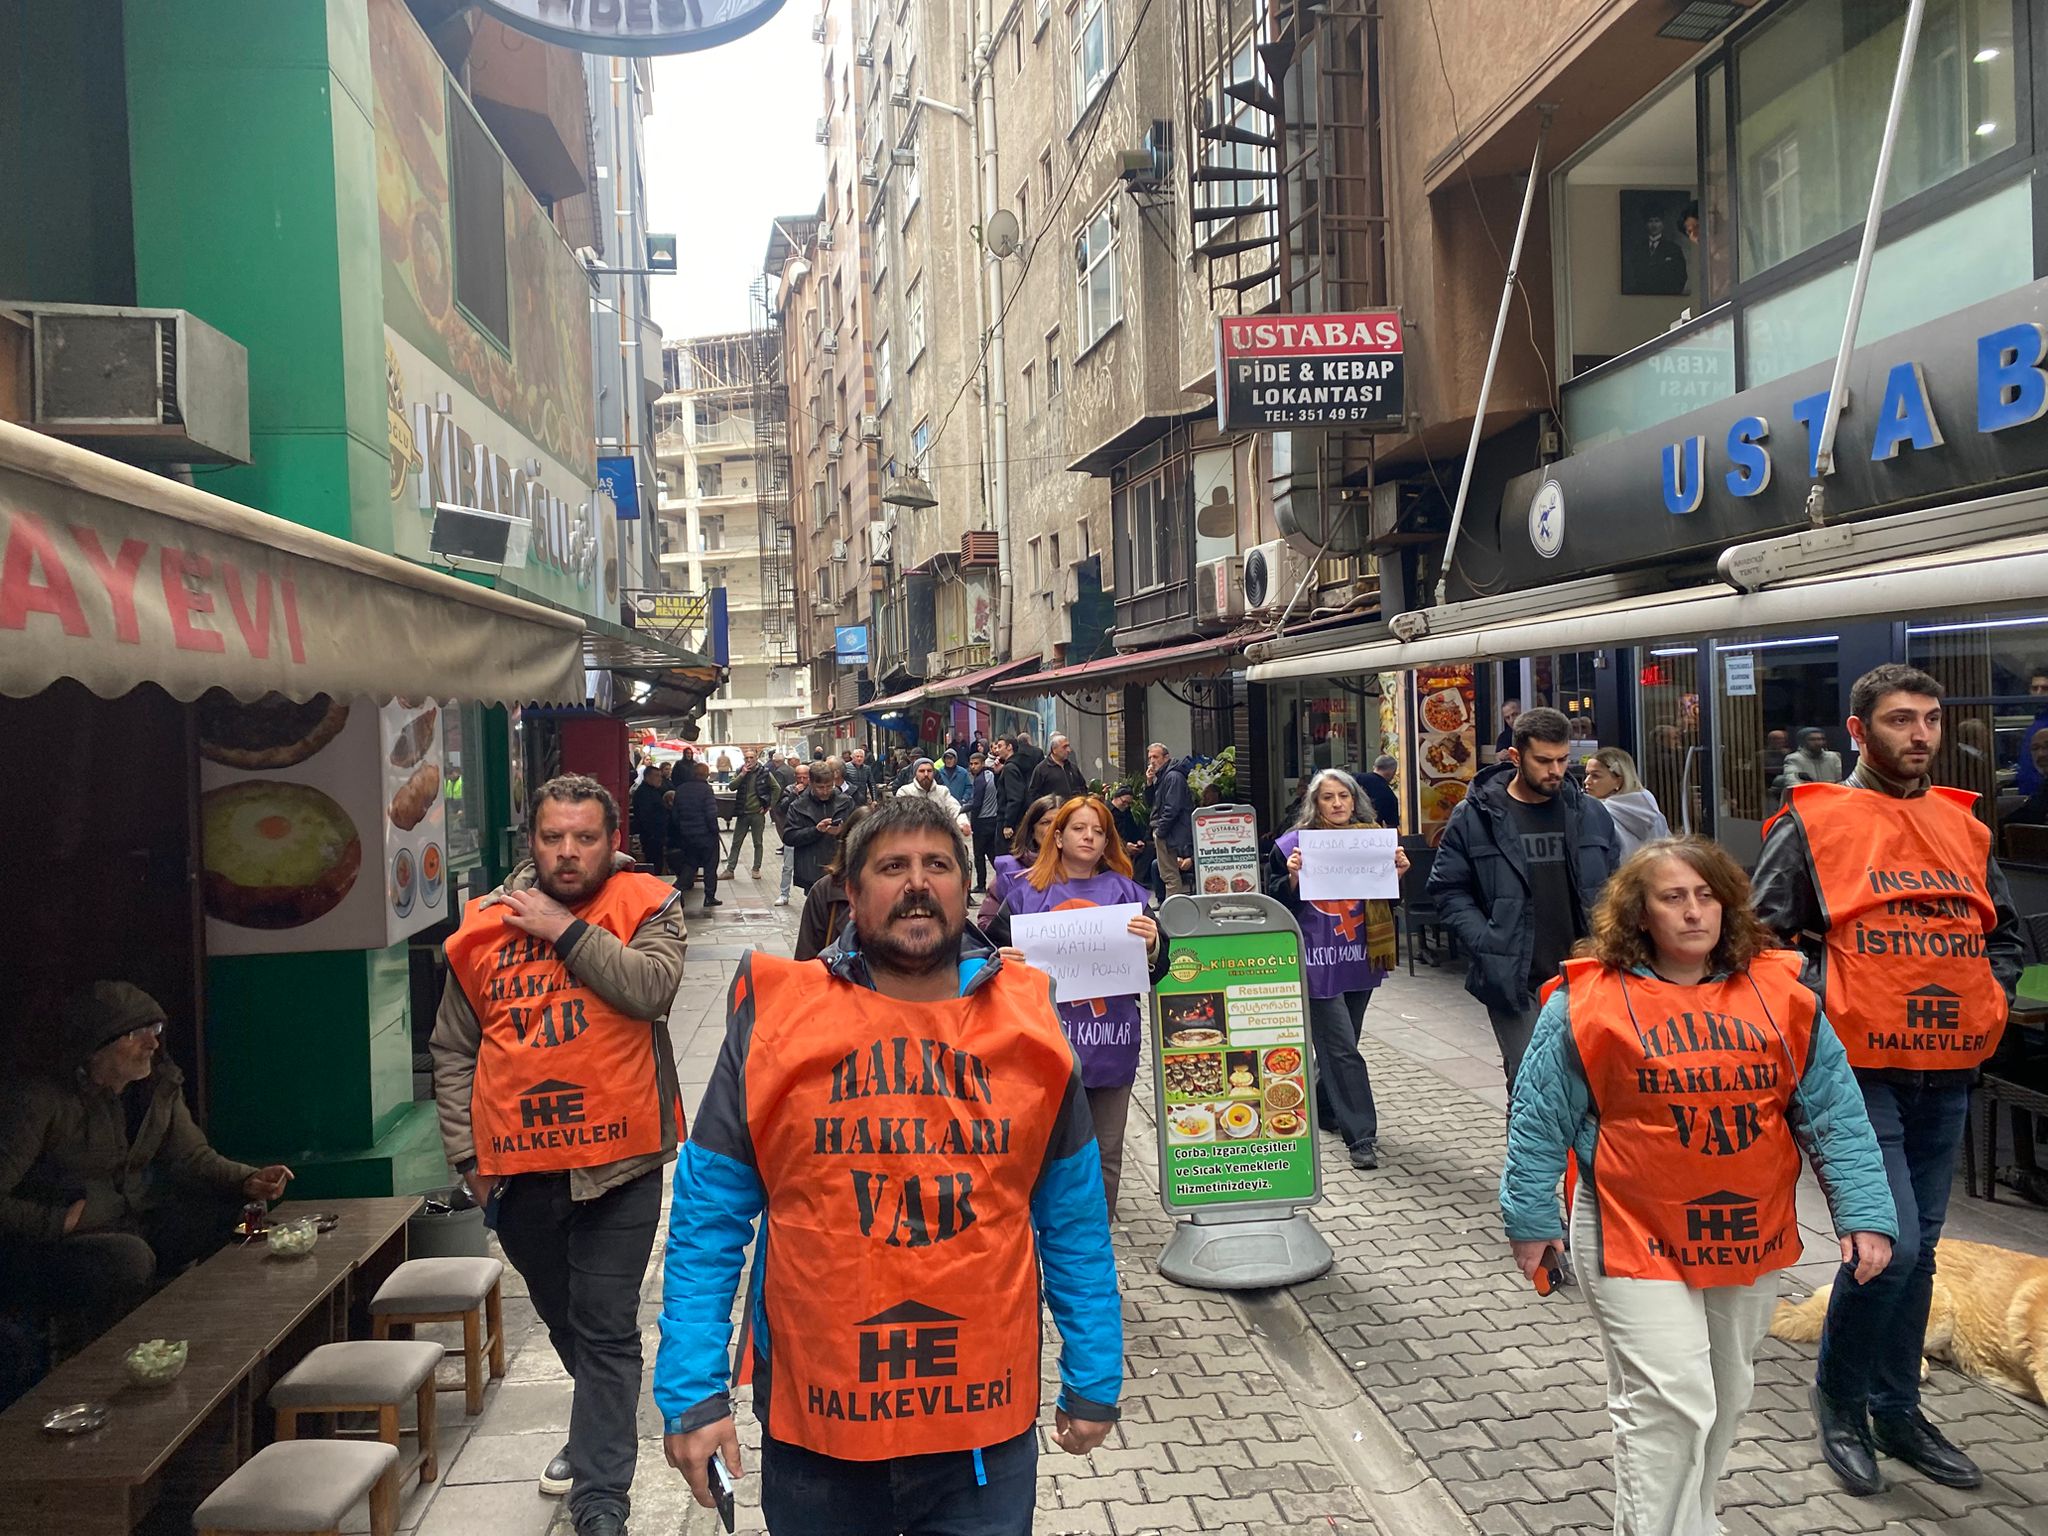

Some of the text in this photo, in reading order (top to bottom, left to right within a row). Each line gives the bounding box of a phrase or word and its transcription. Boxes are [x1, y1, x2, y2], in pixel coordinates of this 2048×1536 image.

[1230, 321, 1397, 350] USTABAŞ
[1239, 360, 1394, 383] PİDE & KEBAP
[1252, 385, 1382, 406] LOKANTASI
[1265, 407, 1368, 422] TEL: 351 49 57
[1200, 846, 1255, 856] Turkish Foods
[1211, 954, 1297, 969] KİBAROĞLU
[1239, 984, 1296, 995] Restaurant
[510, 999, 589, 1048] VAR
[1248, 1015, 1298, 1026] Ресторан
[1077, 1022, 1130, 1045] KADINLAR
[1868, 1031, 1990, 1051] HALKEVLERİ
[829, 1037, 993, 1104] HALKIN
[1636, 1063, 1777, 1094] HAKLARI
[492, 1117, 627, 1153] HALKEVLERİ
[813, 1117, 1012, 1155] HAKLARI
[1667, 1102, 1763, 1156] VAR
[1175, 1141, 1297, 1160] Çorba, Izgara Çeşitleri
[1176, 1161, 1289, 1177] ve Sıcak Yemeklerle
[1176, 1179, 1272, 1195] Hizmetinizdeyiz.
[850, 1169, 977, 1247] VAR
[808, 1370, 1012, 1422] HALKEVLERİ
